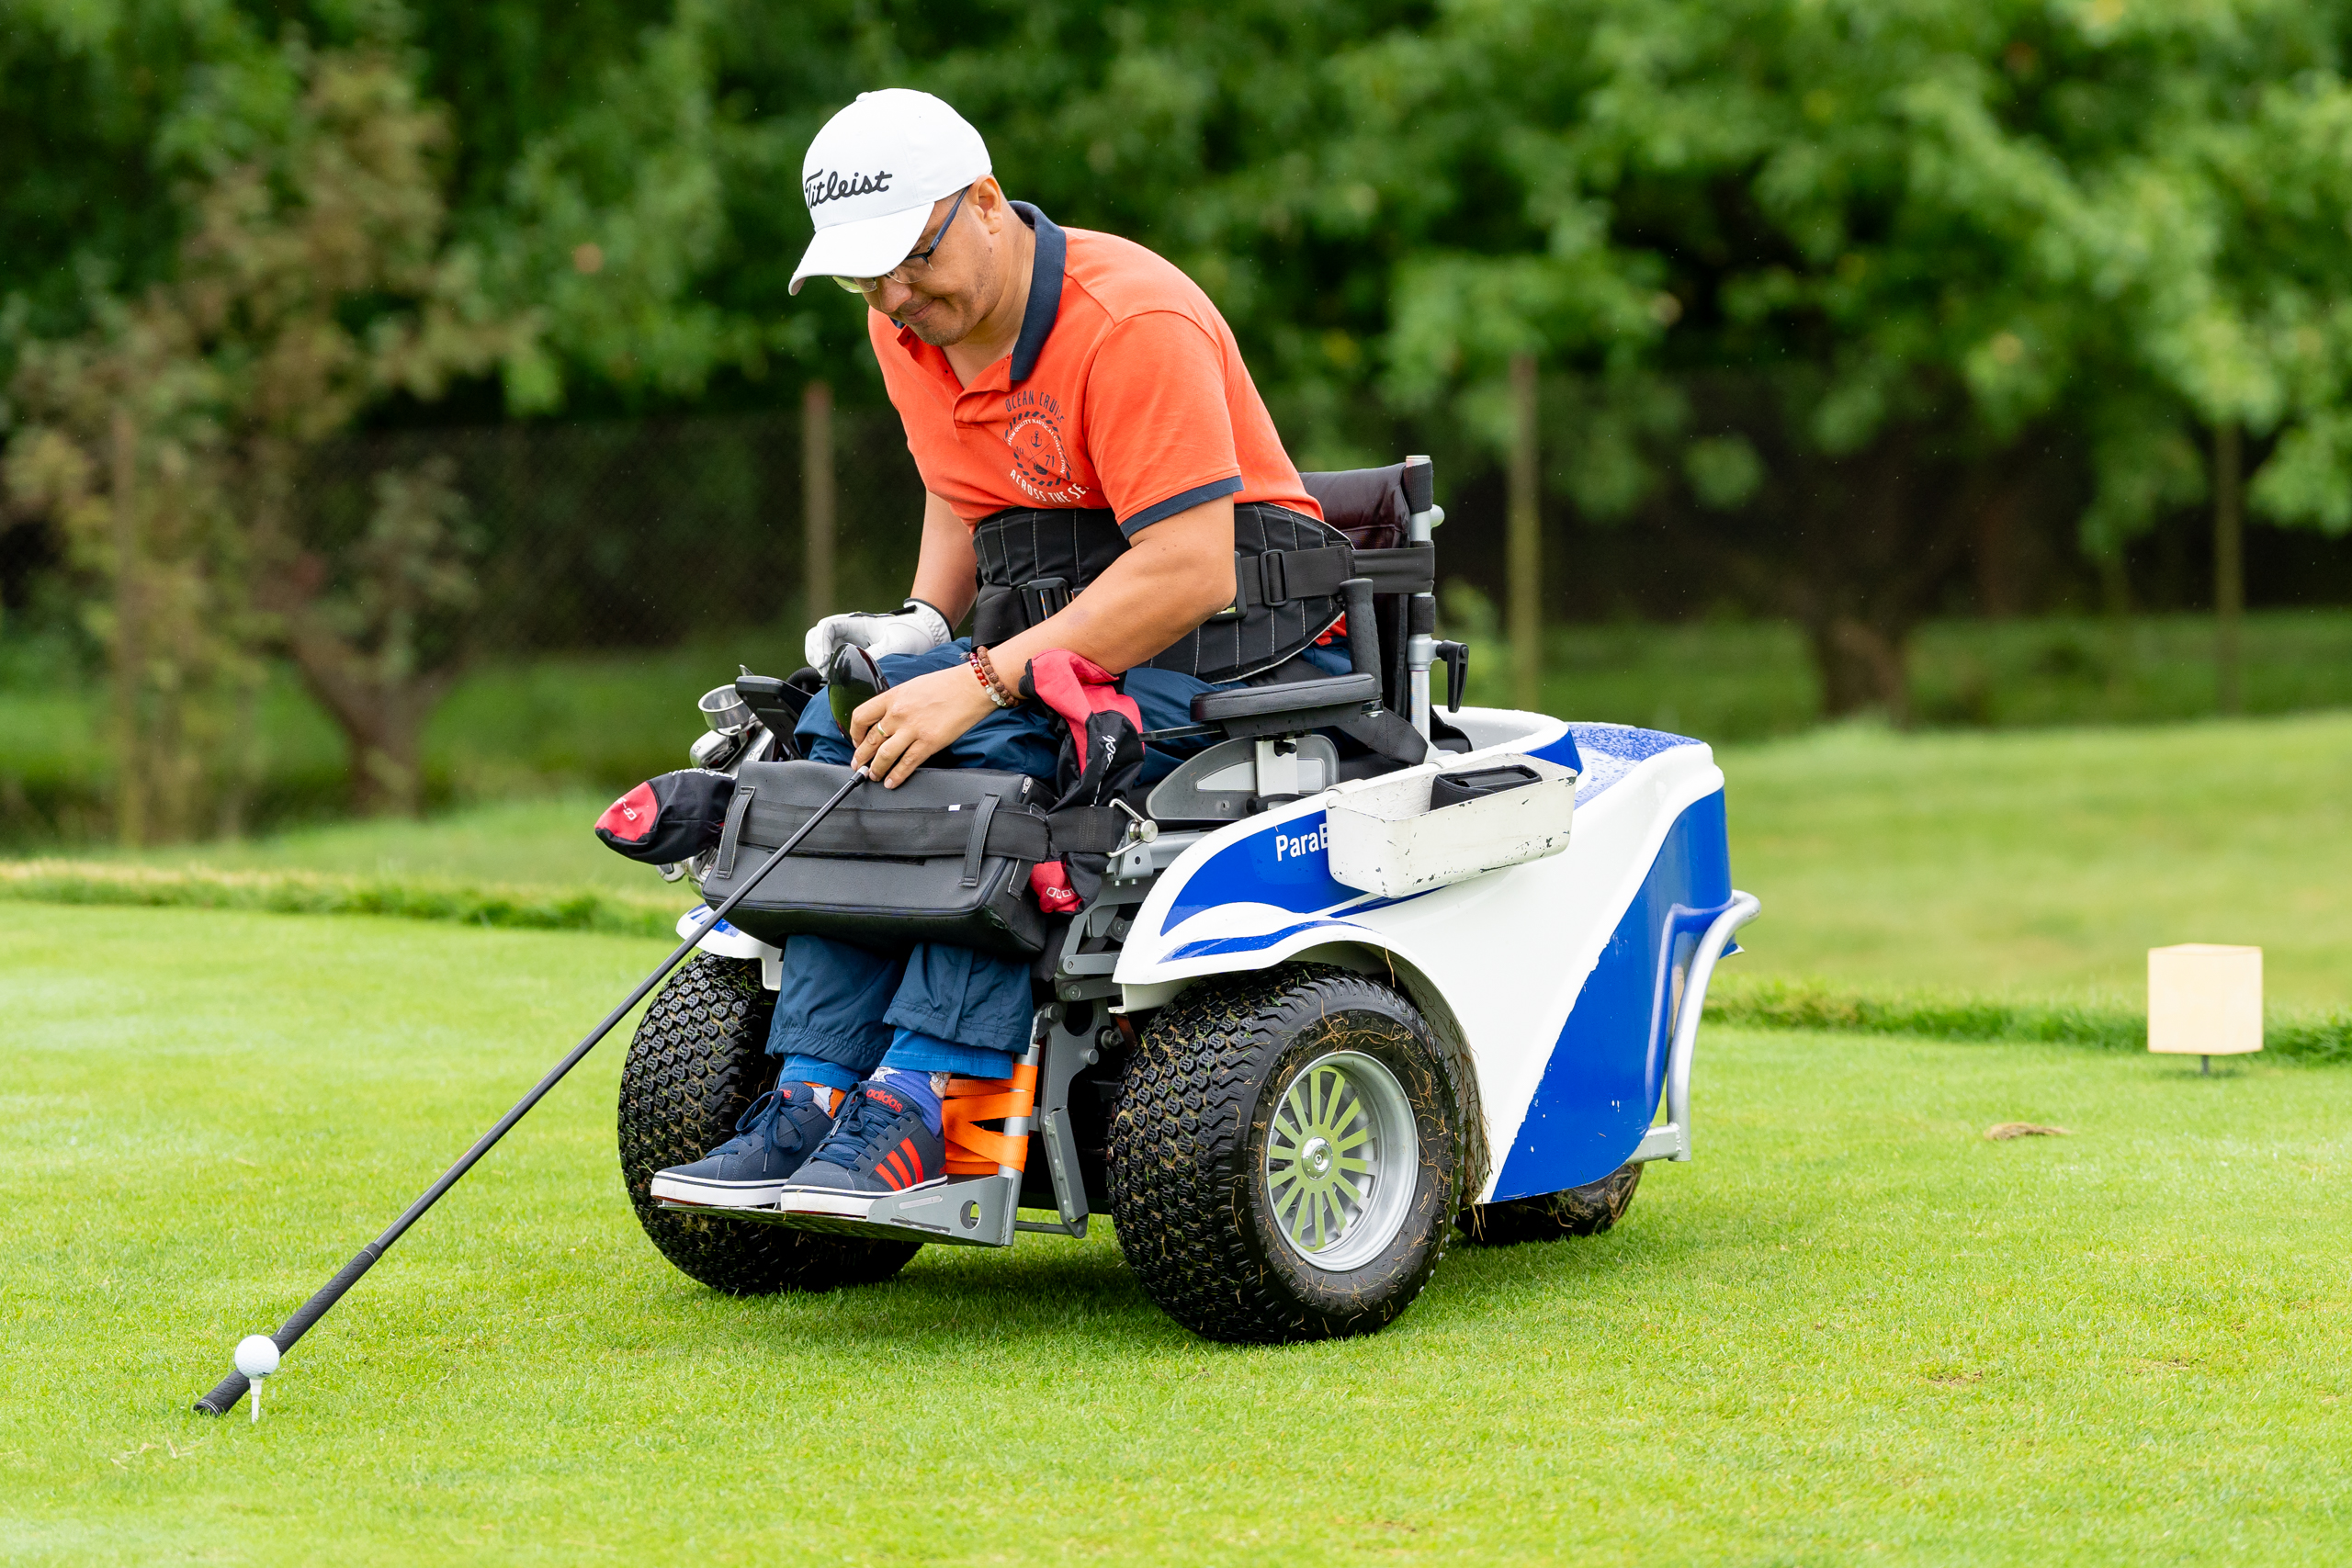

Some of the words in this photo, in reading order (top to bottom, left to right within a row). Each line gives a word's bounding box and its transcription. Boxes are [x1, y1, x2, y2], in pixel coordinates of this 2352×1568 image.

[805, 169, 893, 209] Titleist
[1005, 389, 1035, 412] OCEAN
[1032, 419, 1054, 437] NAUTICAL
[1046, 455, 1055, 468] 71
[1010, 468, 1047, 502] ACROSS
[1047, 491, 1072, 503] THE
[1068, 482, 1091, 500] SE
[865, 1088, 903, 1113] adidas
